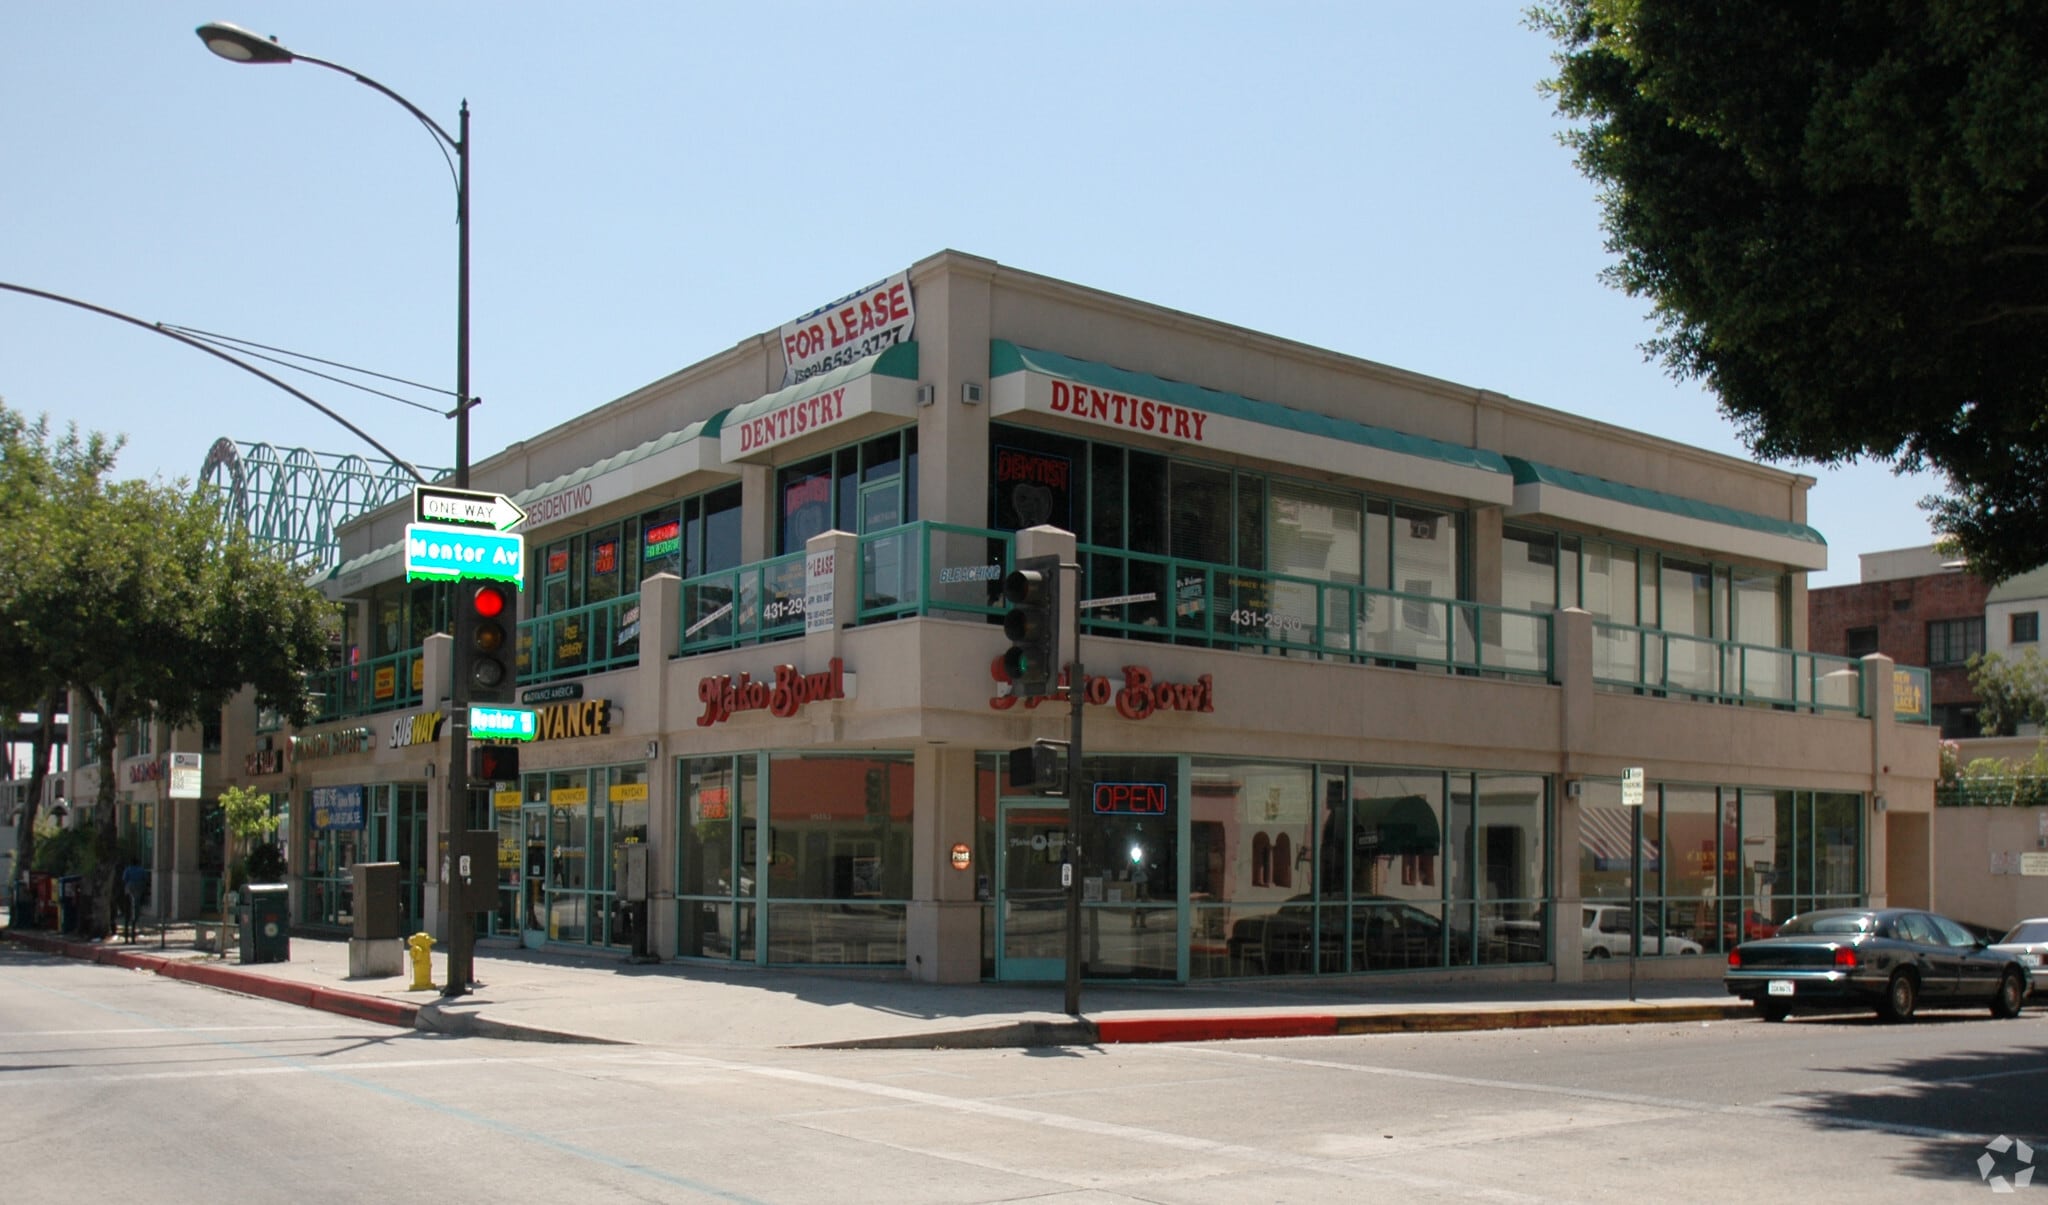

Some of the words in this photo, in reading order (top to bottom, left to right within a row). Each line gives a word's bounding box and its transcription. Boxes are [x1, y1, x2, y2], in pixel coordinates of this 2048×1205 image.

[784, 324, 825, 365] FOR
[826, 282, 909, 349] LEASE
[740, 387, 846, 452] DENTISTRY
[1050, 380, 1208, 441] DENTISTRY
[998, 451, 1069, 491] DENTIST
[429, 500, 457, 514] ONE
[464, 504, 494, 518] WAY
[519, 483, 592, 530] RESiDENTWO
[411, 538, 485, 563] Mentor
[492, 546, 518, 566] Av
[814, 555, 833, 577] LEASE
[939, 565, 1001, 583] BLEACHING
[1230, 609, 1301, 631] 431-2930
[552, 686, 574, 697] AMERICA
[697, 671, 770, 727] Mako
[770, 657, 844, 718] Bowl
[1116, 665, 1214, 720] Bowl
[389, 710, 443, 748] SUBWAY
[1096, 785, 1165, 812] OPEN
